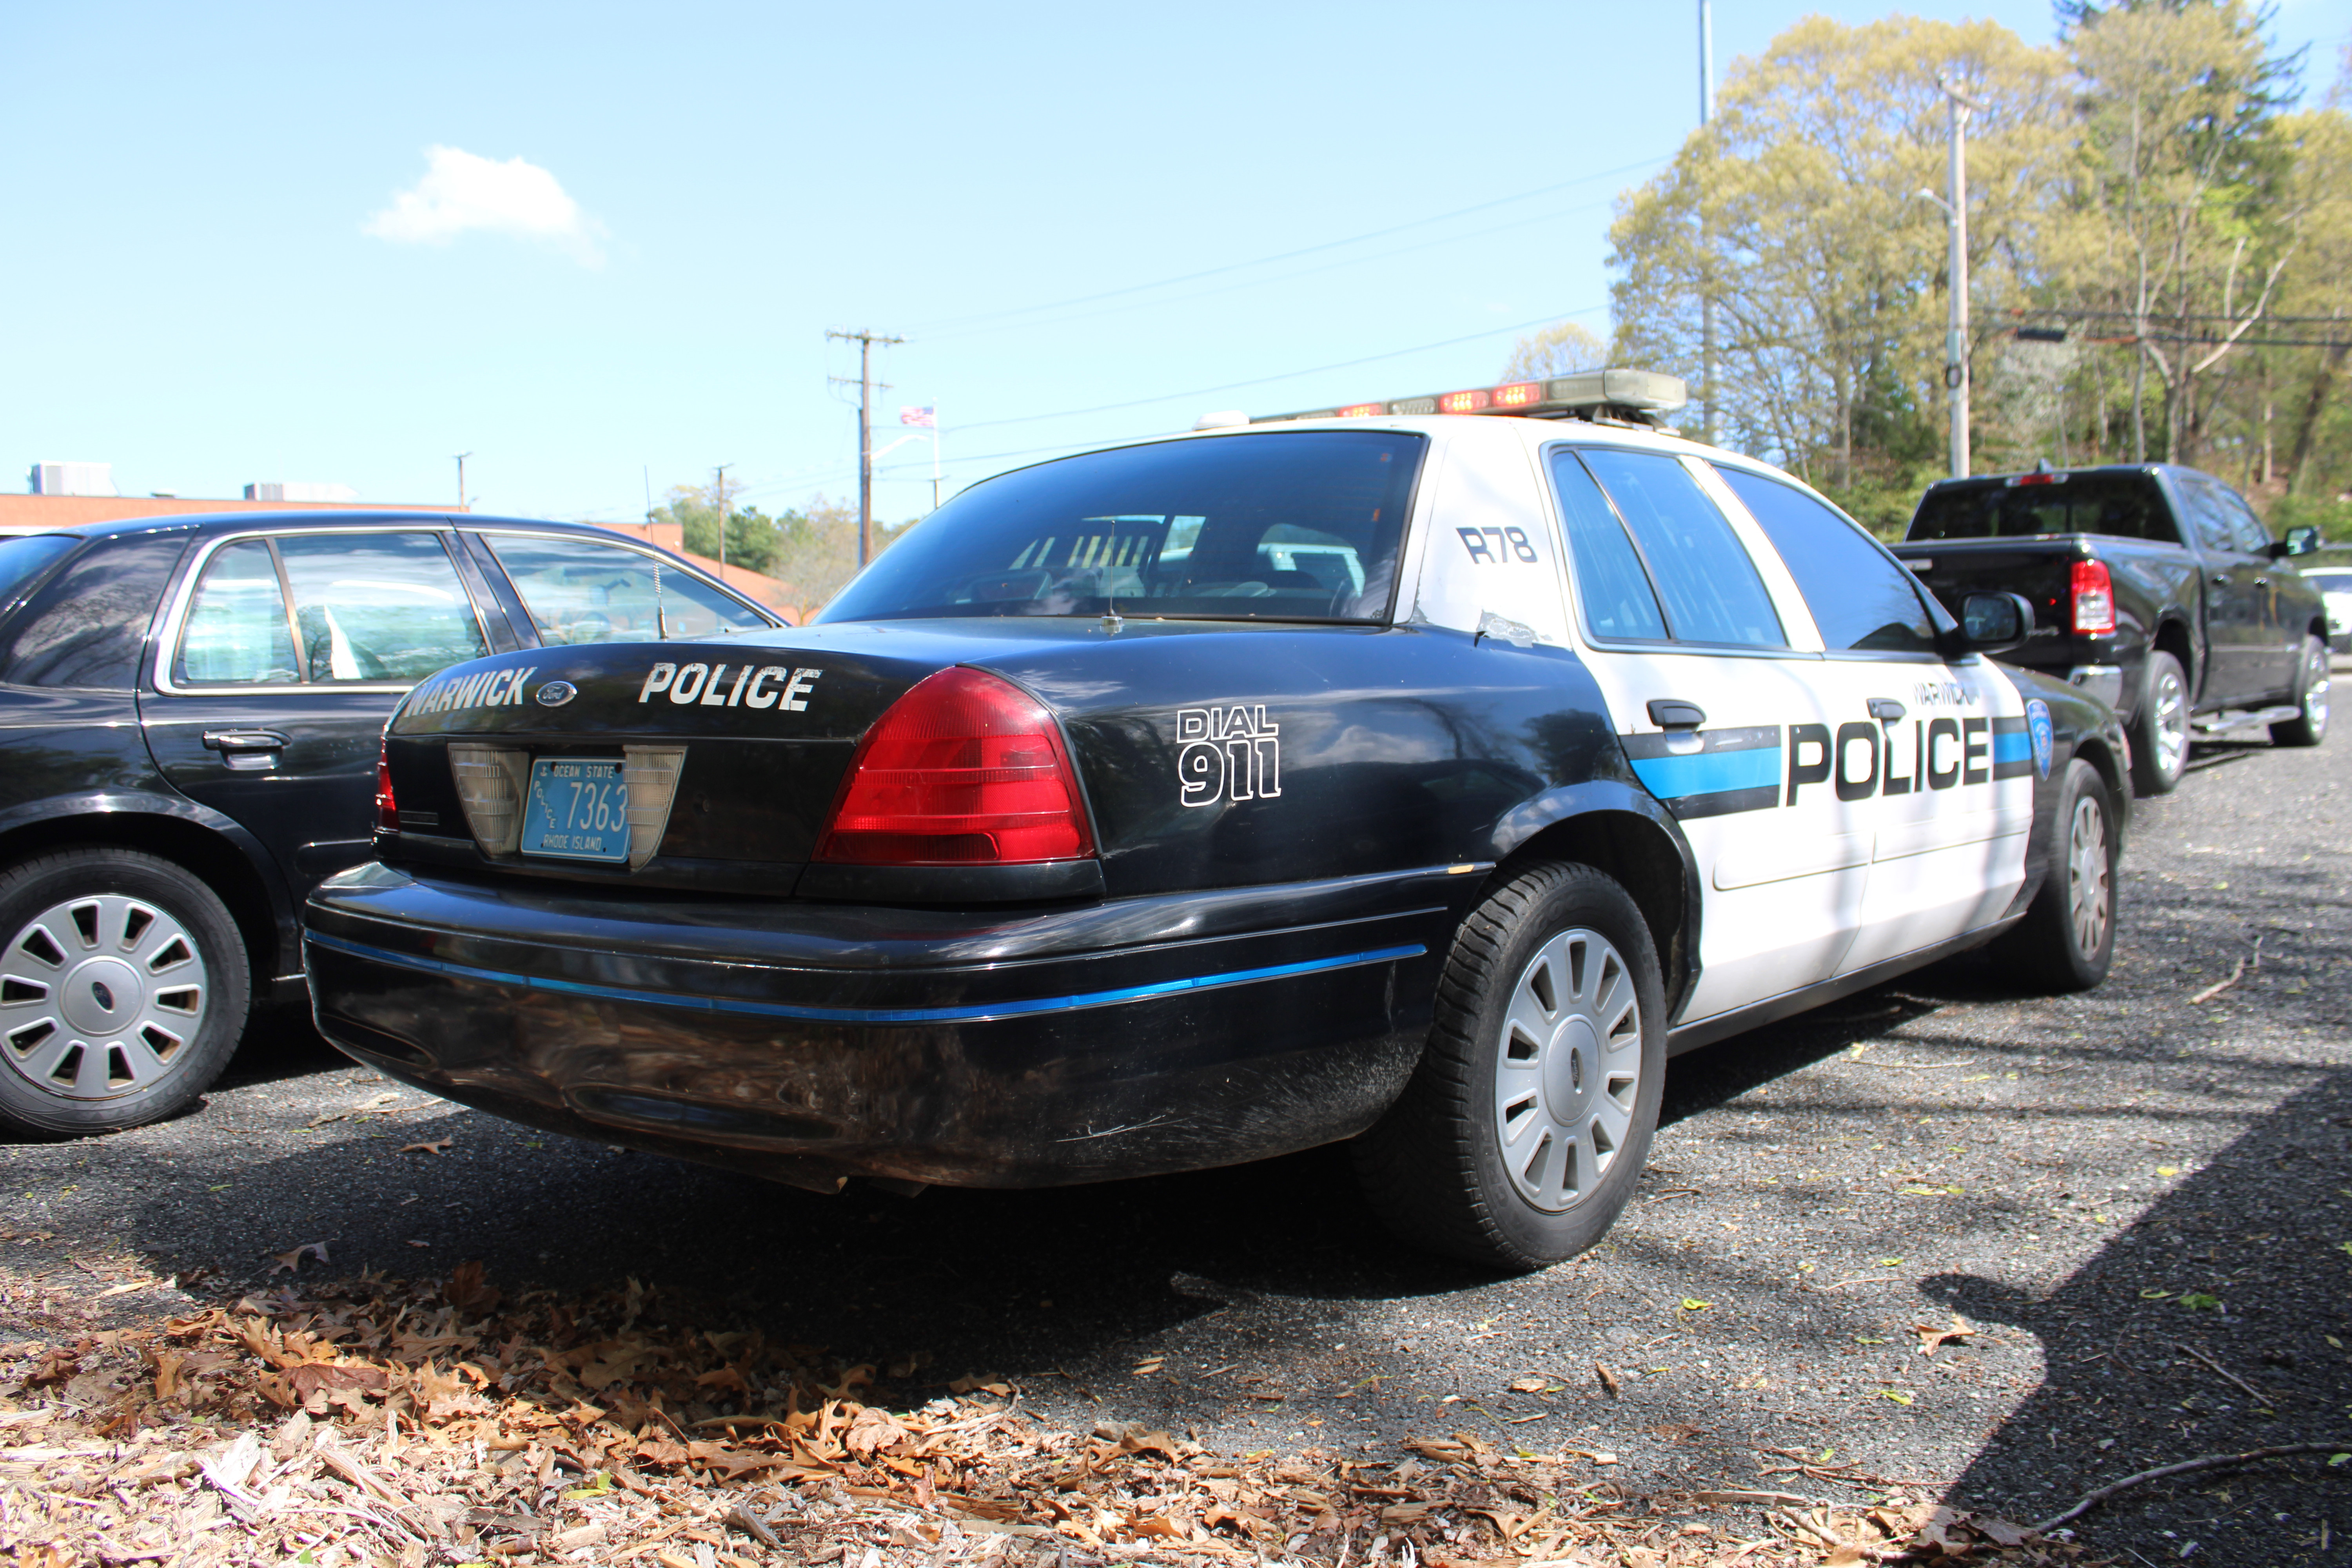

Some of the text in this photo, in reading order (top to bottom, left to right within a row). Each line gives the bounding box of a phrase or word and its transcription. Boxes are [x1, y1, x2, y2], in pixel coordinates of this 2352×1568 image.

[1455, 526, 1538, 564] R78
[404, 667, 538, 718] WARWICK
[639, 662, 823, 711] POLICE
[1177, 705, 1279, 743] DIAL
[554, 766, 615, 779] OCEAN STATE
[1178, 737, 1281, 808] 911
[1786, 717, 1989, 807] POLICE
[534, 780, 556, 829] POLICE
[567, 782, 627, 832] 7363
[543, 834, 602, 851] RHODE ISLAND
